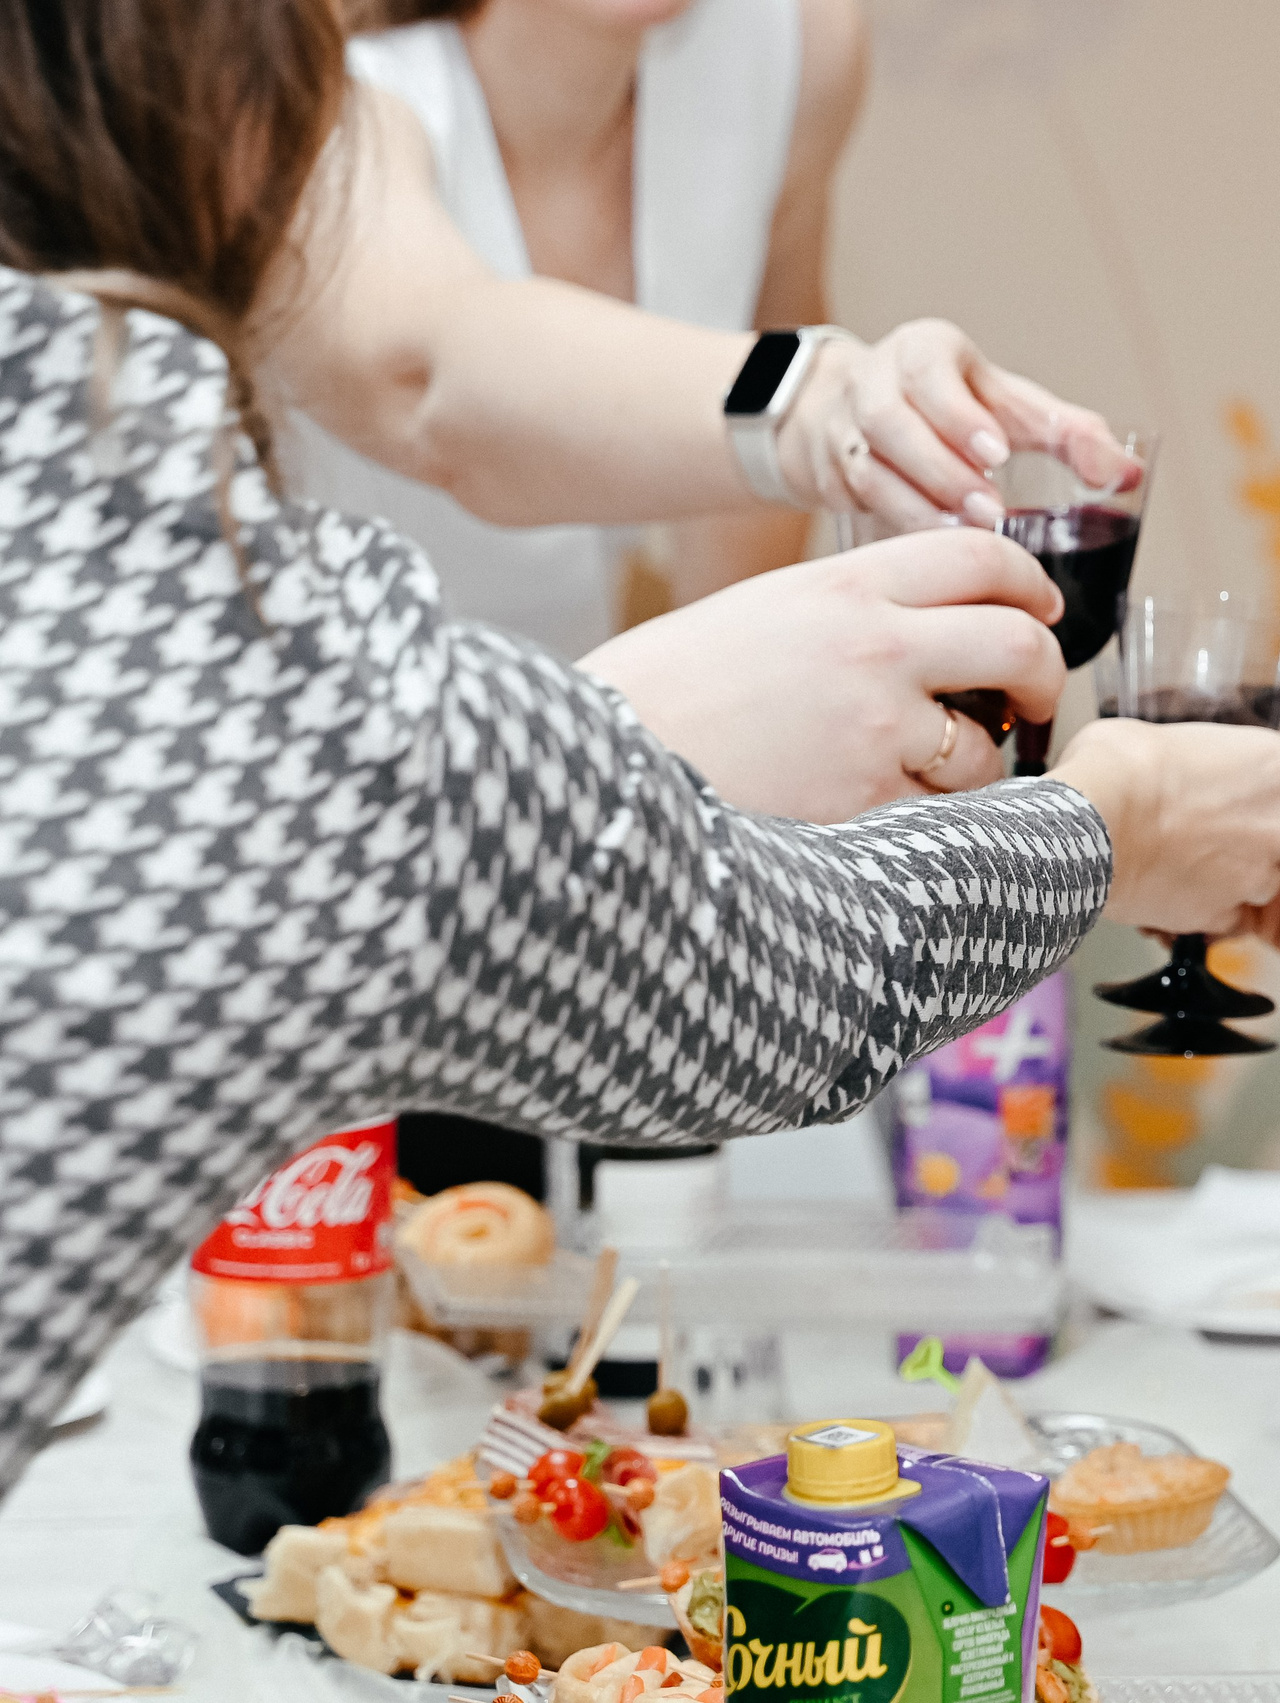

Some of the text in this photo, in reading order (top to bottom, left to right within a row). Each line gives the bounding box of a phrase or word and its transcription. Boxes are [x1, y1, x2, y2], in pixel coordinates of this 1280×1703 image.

[720, 1497, 881, 1547] РАЗЫГРЫВАЕМ АВТОМОБИЛЬ
[758, 1541, 799, 1564] ПРИЗЫ!
